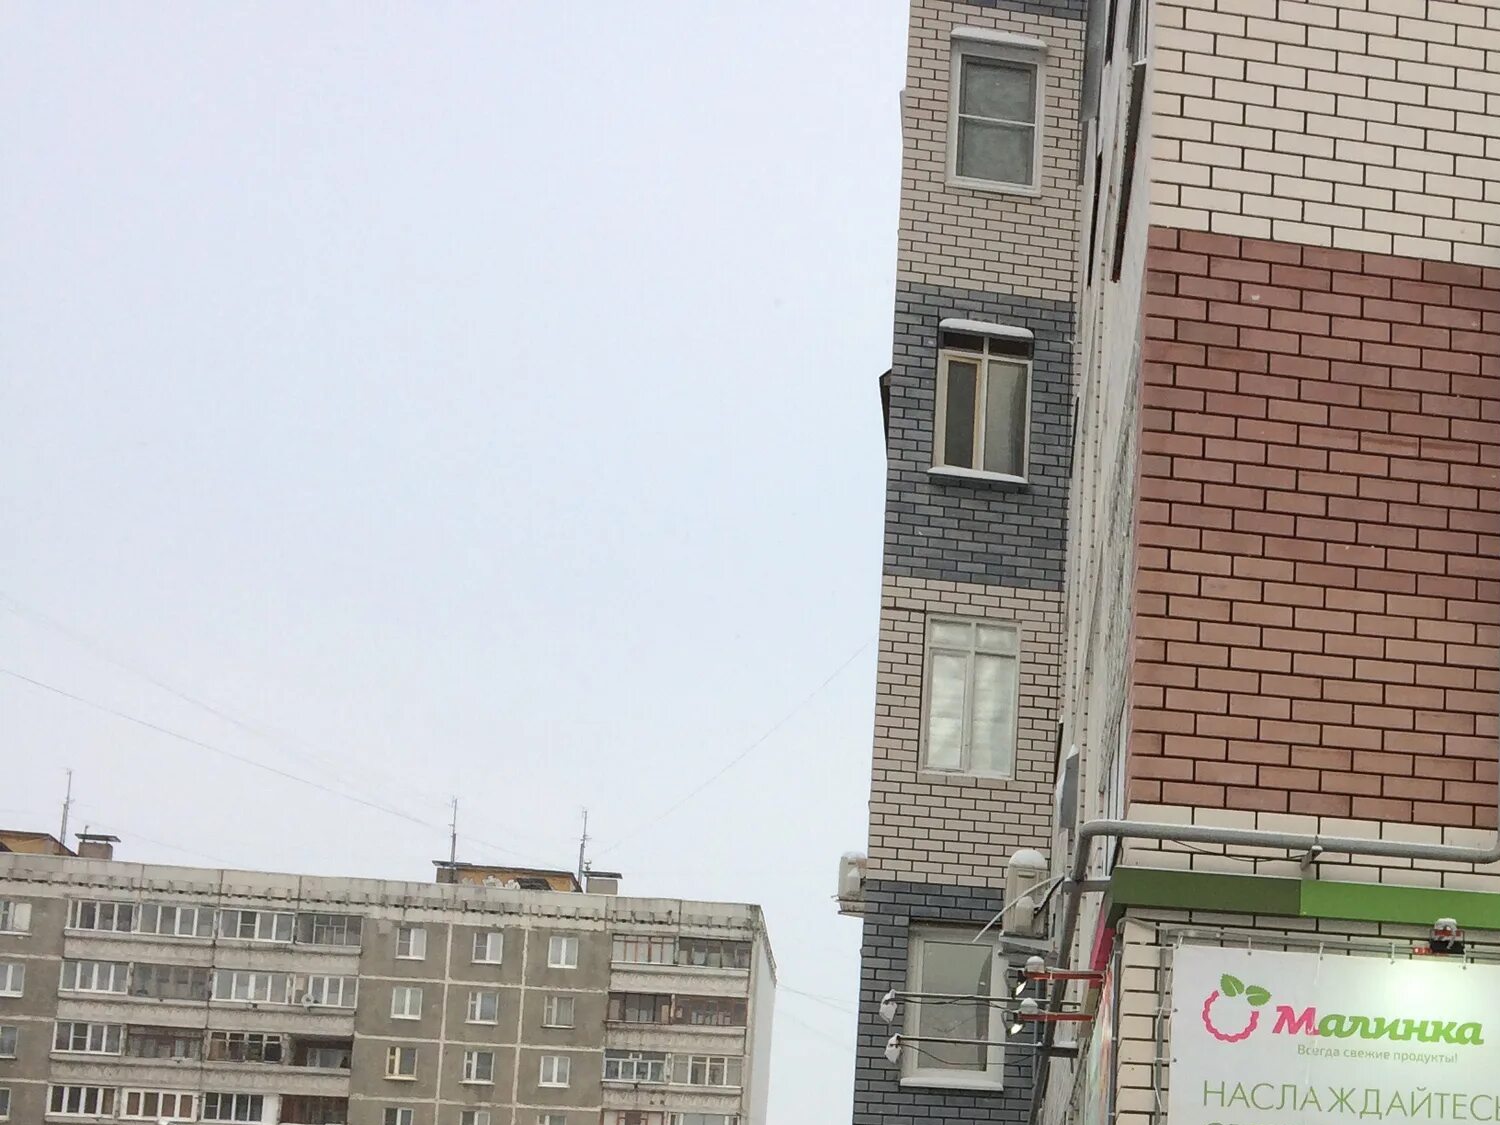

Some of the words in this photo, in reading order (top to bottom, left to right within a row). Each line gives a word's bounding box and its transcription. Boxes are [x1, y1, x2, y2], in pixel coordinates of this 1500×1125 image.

[1271, 1005, 1485, 1046] Малинка
[1297, 1044, 1340, 1059] Всегда
[1343, 1048, 1390, 1060] свежие
[1393, 1050, 1458, 1065] продукты!
